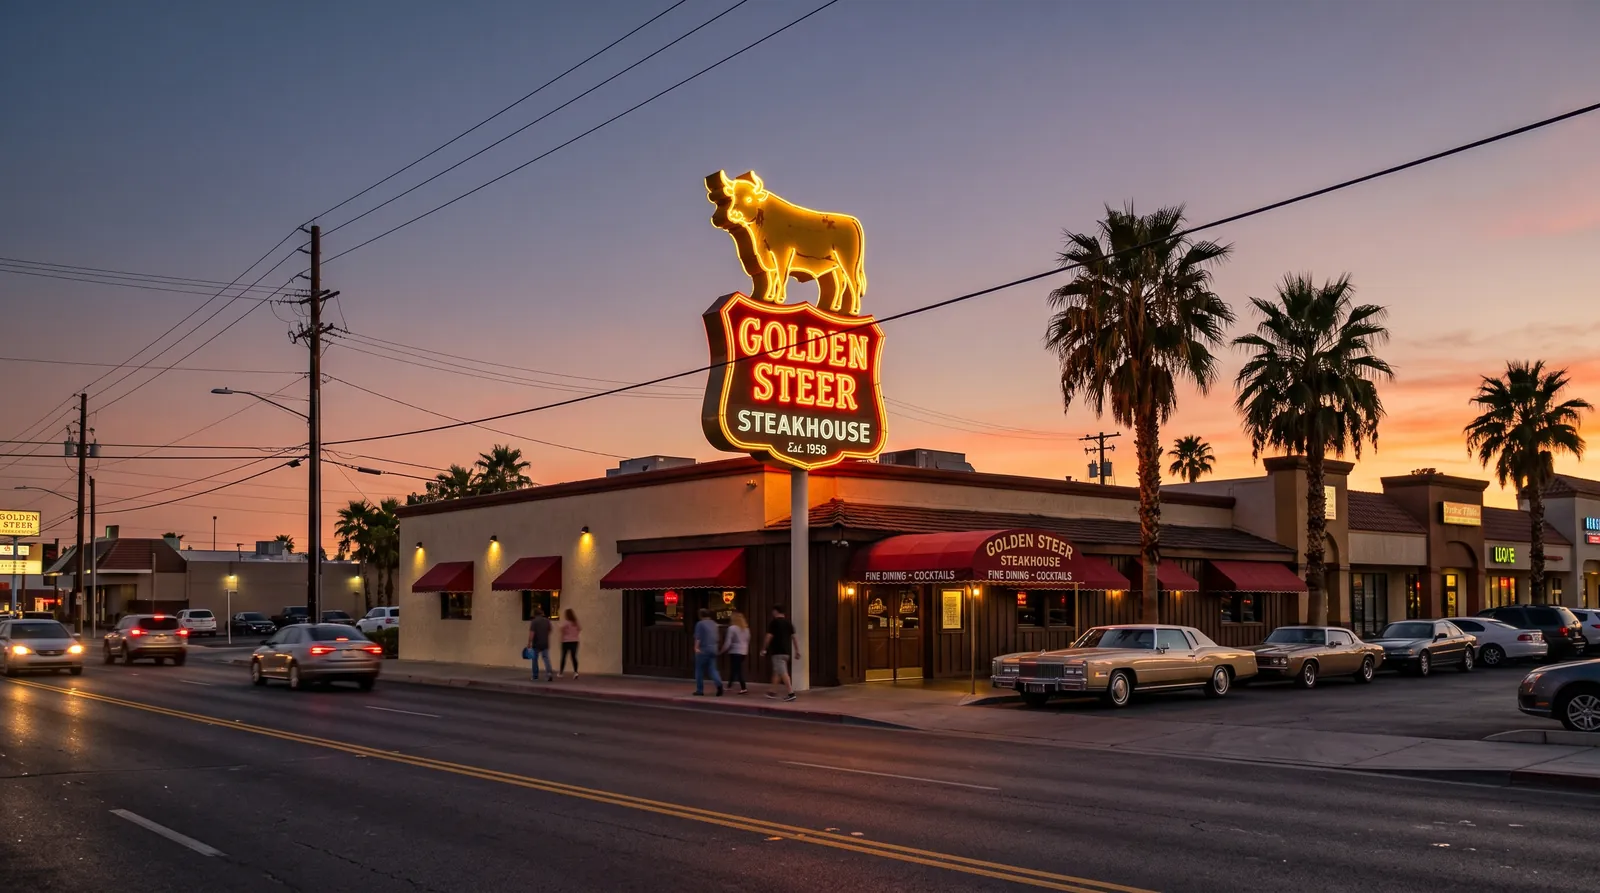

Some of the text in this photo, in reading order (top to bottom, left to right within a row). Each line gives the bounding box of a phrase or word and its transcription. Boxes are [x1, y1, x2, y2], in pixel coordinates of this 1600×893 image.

[739, 317, 869, 370] GOLDEN
[753, 362, 858, 410] STEER
[738, 410, 870, 443] STEAKHOUSE
[806, 443, 827, 455] 1958
[3, 521, 33, 529] STEER
[986, 534, 1073, 560] GOLDEN STEER
[1000, 555, 1061, 567] STEAKHOUSE
[865, 571, 880, 580] FINE
[882, 571, 907, 580] DINING
[914, 570, 955, 580] COCKTAILS
[988, 570, 1004, 580] FINE
[1005, 570, 1030, 580] DINING
[1036, 571, 1072, 581] COCKTAILS
